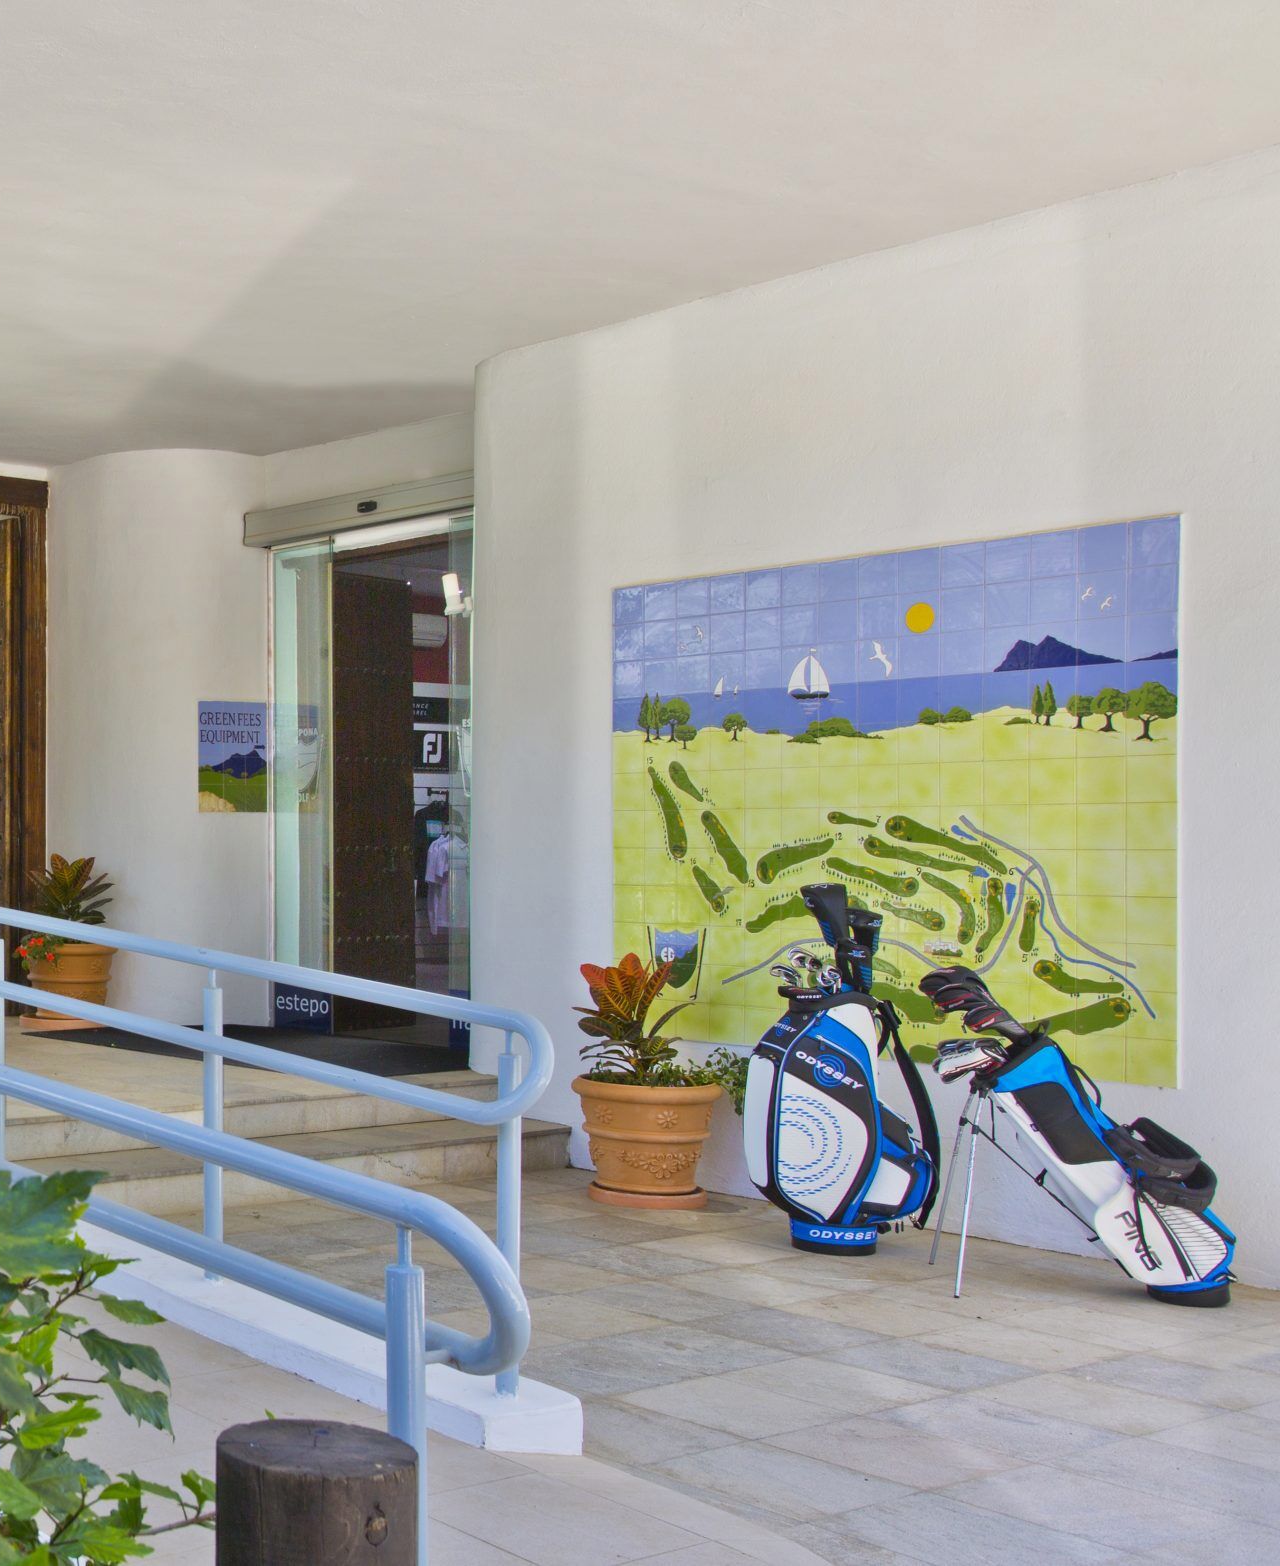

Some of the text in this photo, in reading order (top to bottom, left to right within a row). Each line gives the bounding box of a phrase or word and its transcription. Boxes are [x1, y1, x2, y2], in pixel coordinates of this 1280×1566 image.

[200, 729, 260, 744] EQUIPMENT
[422, 733, 443, 764] FJ
[835, 832, 843, 841] 12
[821, 860, 826, 870] 8
[916, 867, 922, 877] 9
[1008, 867, 1014, 876] 6
[974, 954, 984, 964] 10
[1022, 953, 1028, 963] 5
[276, 994, 329, 1017] estepo
[795, 1050, 865, 1089] ODYSSEY
[809, 1229, 877, 1240] ODYSSEY
[1114, 1210, 1162, 1271] PING
